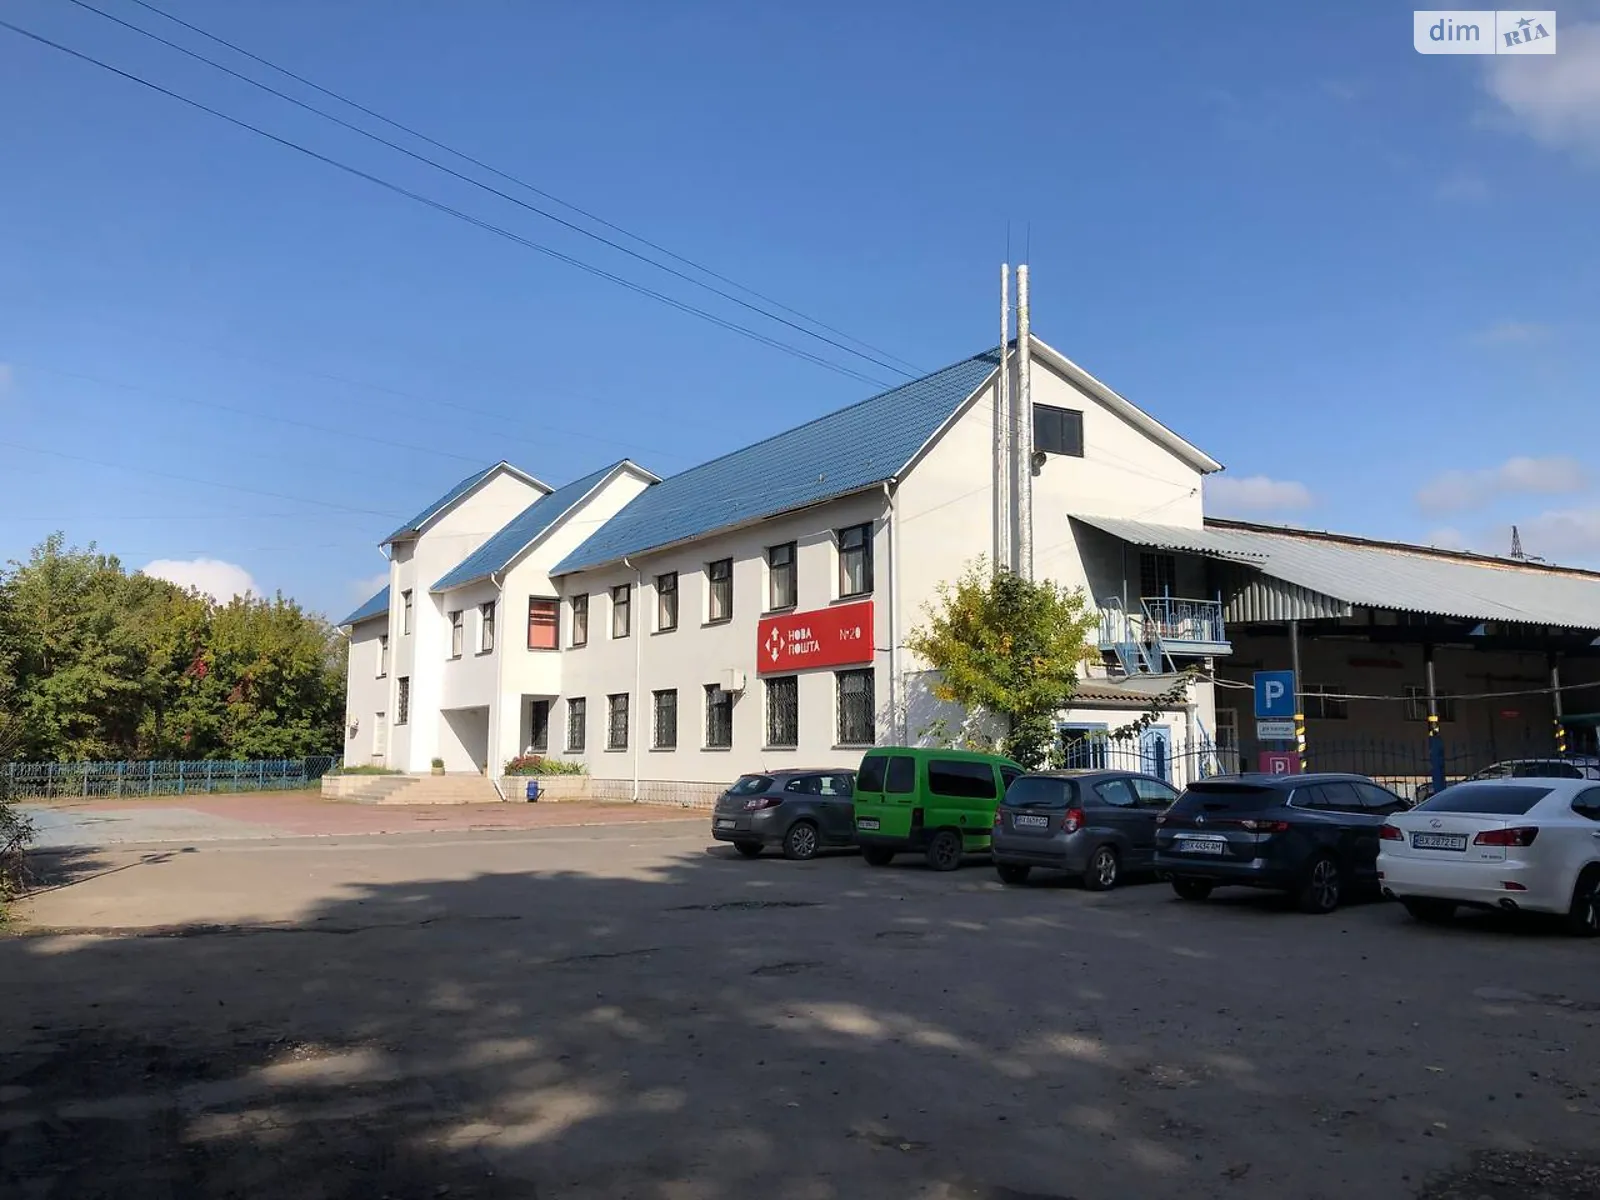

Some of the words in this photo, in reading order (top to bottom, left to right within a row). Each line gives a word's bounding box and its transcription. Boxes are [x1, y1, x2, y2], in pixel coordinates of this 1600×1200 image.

[788, 627, 812, 641] НОВА
[788, 640, 820, 655] ПОШТА
[1265, 680, 1284, 709] P
